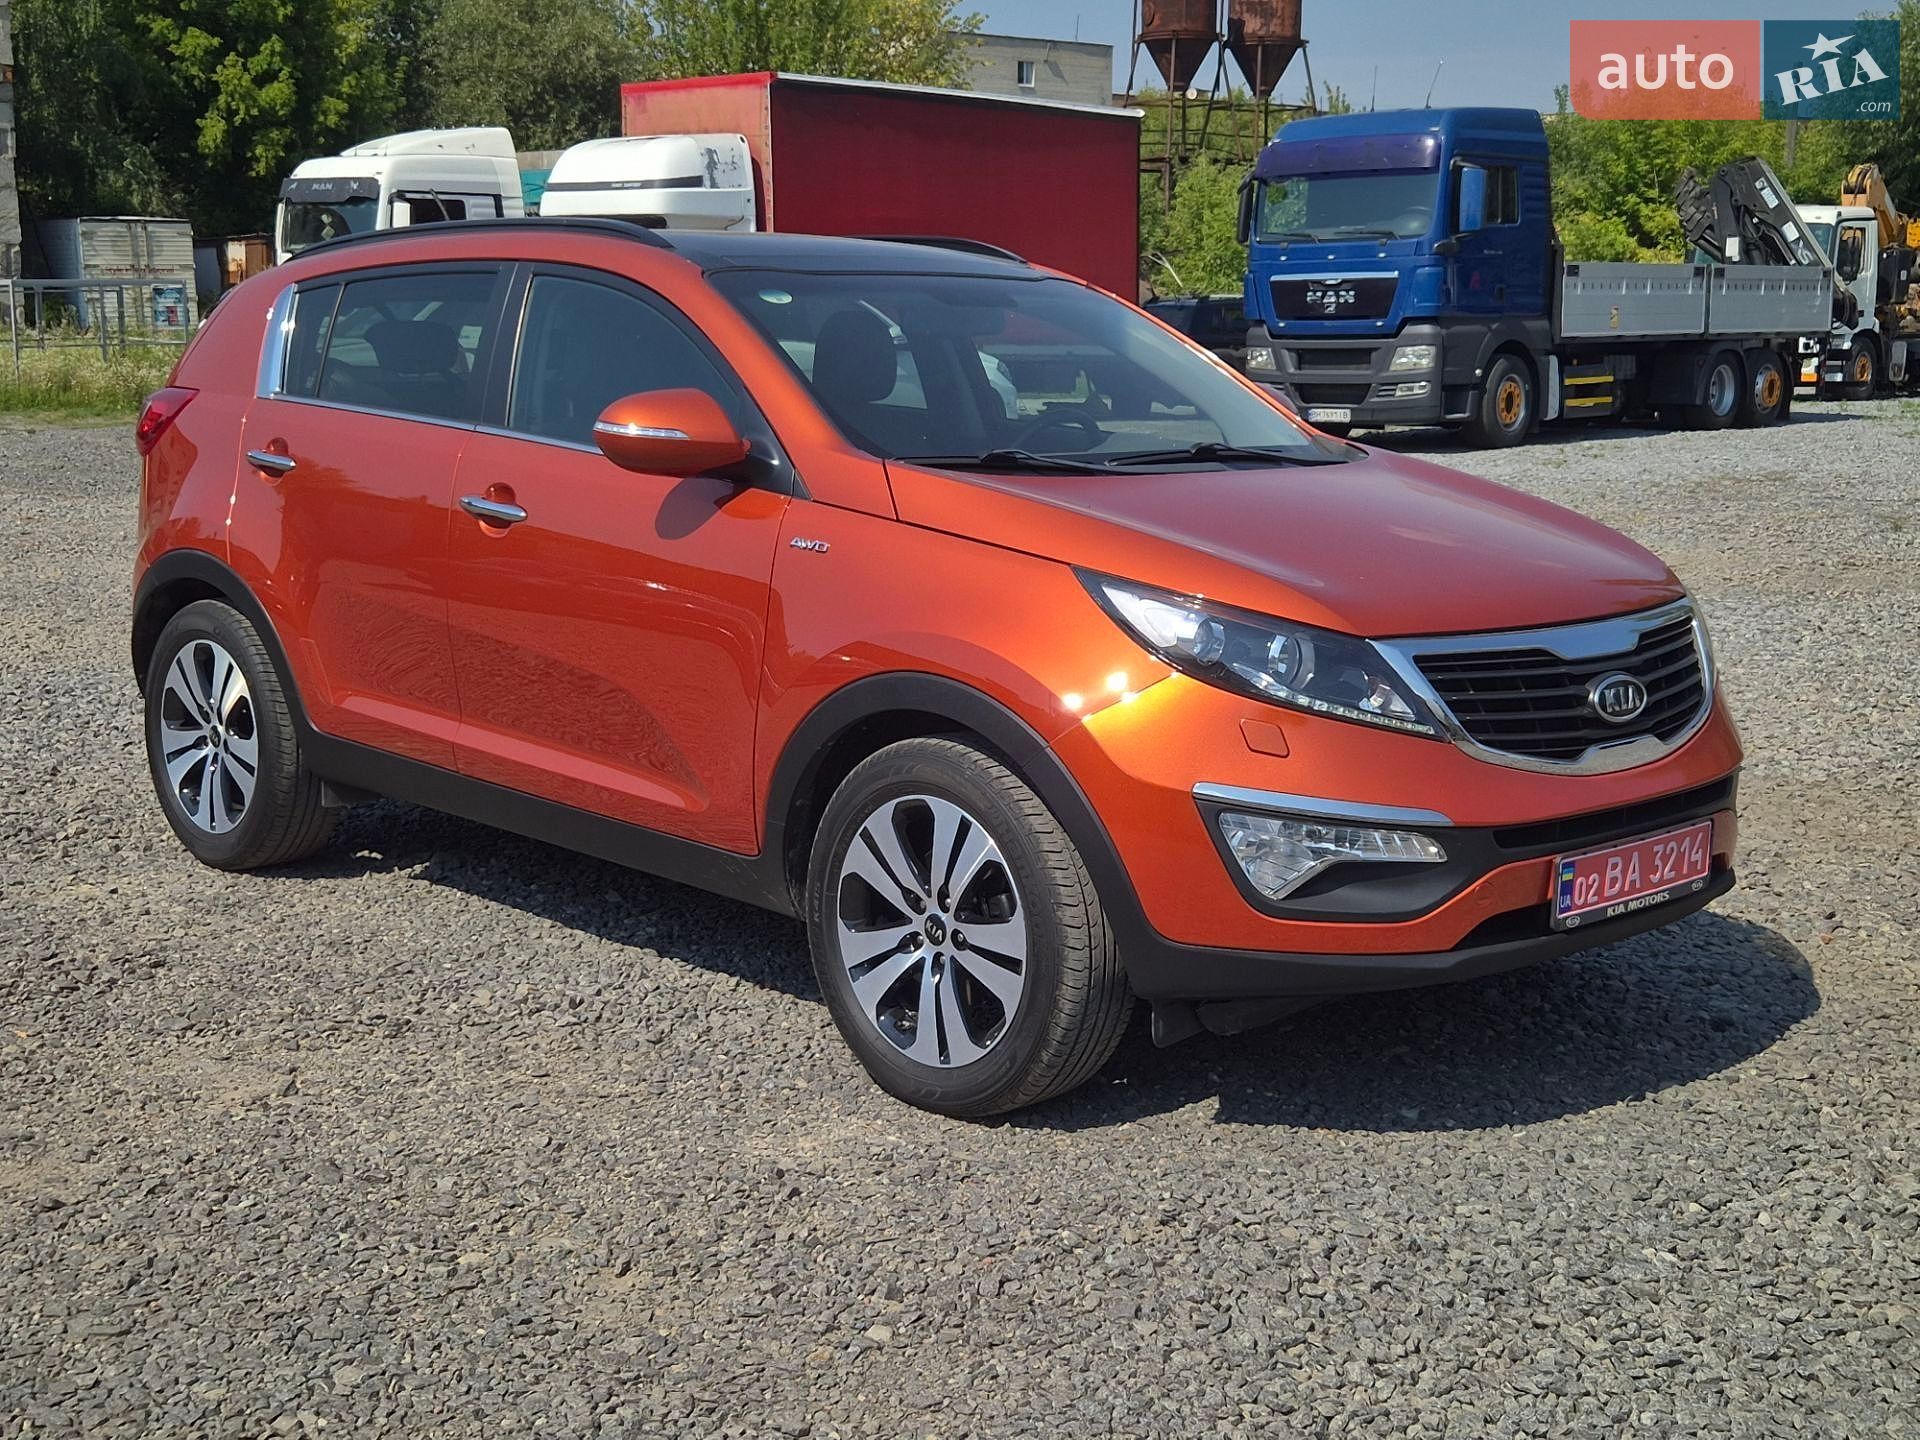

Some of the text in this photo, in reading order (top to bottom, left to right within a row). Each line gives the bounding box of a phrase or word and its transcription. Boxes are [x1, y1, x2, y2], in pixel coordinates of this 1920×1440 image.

[1306, 290, 1356, 303] MAN
[790, 536, 829, 552] AWD
[1604, 685, 1641, 713] KIA
[1574, 832, 1703, 906] 02 BA 3214
[1560, 894, 1572, 908] UA
[1607, 891, 1670, 917] KIA MOTORS
[926, 919, 943, 942] KIA
